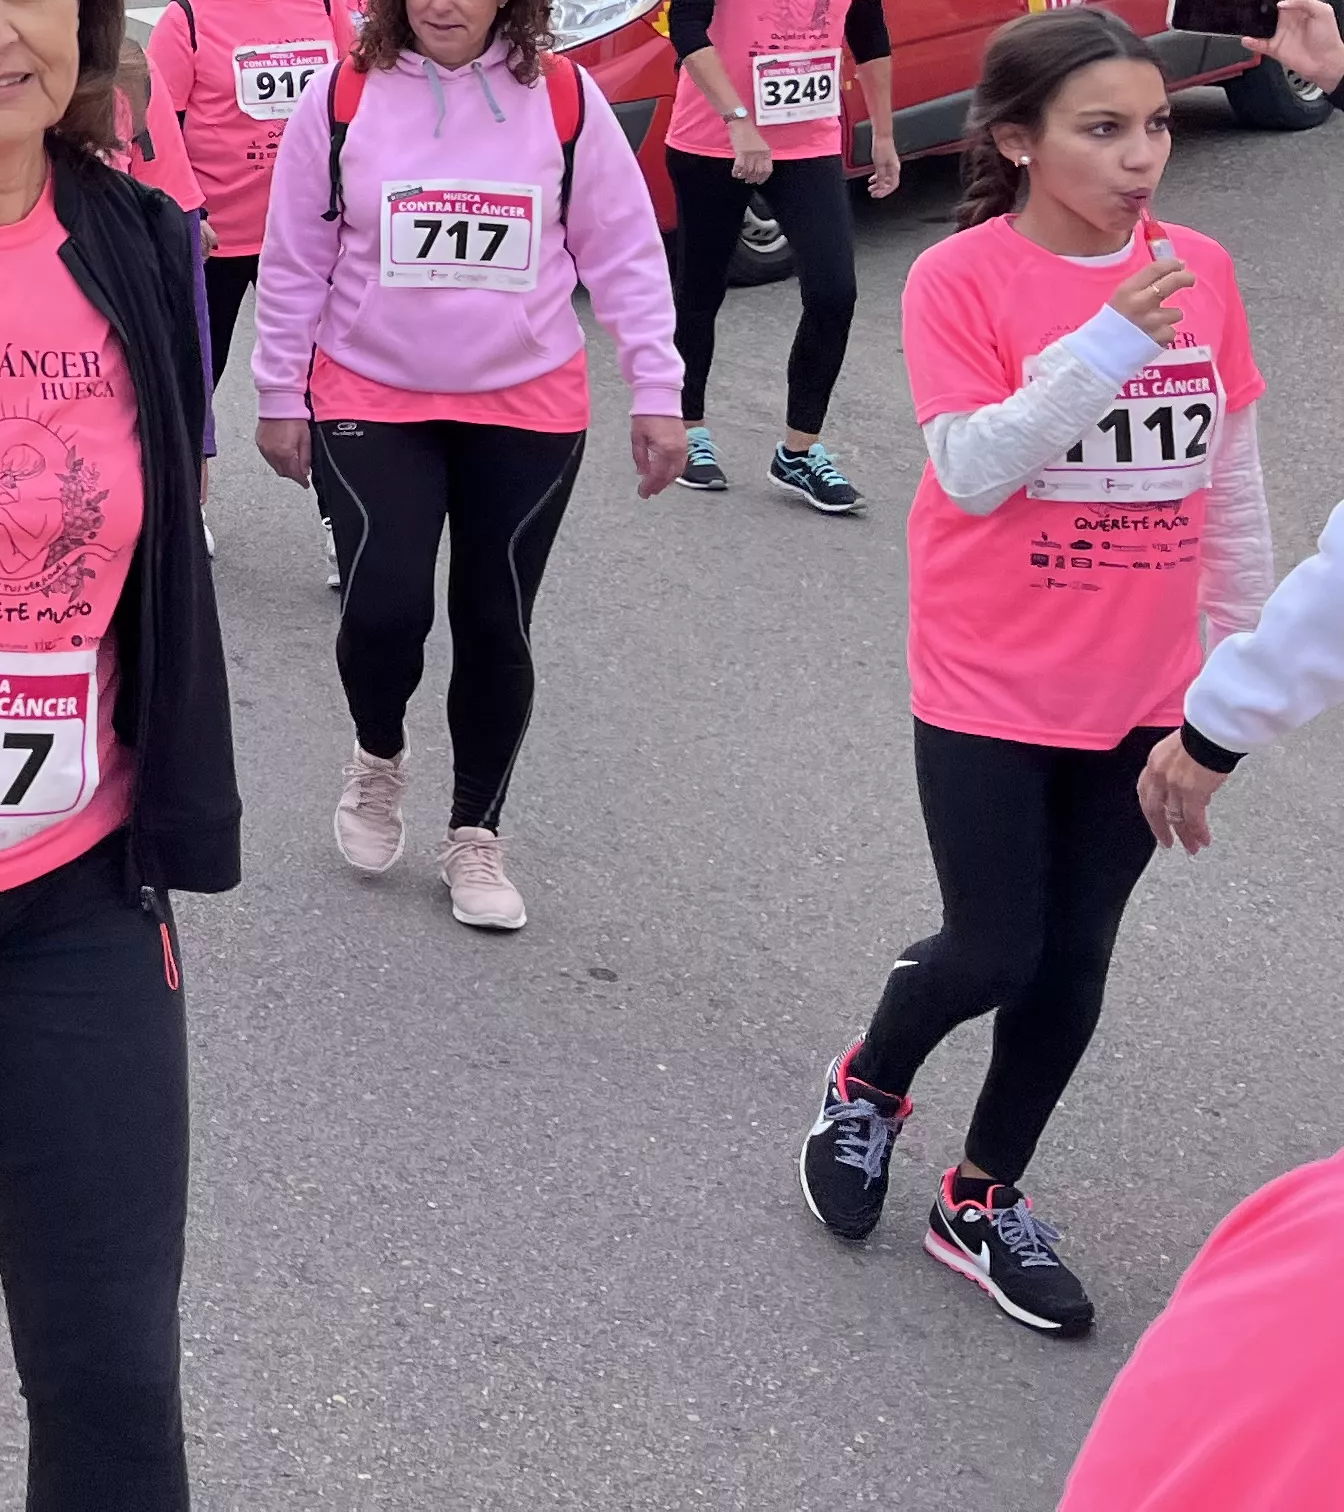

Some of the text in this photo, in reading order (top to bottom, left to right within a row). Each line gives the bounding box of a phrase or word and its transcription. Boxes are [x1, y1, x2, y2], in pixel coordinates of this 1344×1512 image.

[290, 56, 324, 66] CÁNCER
[763, 75, 831, 106] 3249
[443, 192, 481, 203] HUESCA
[398, 202, 525, 218] CONTRA EL CÁNCER
[413, 219, 509, 262] 717
[41, 381, 116, 401] HUESCA
[1130, 377, 1211, 396] EL CÁNCER
